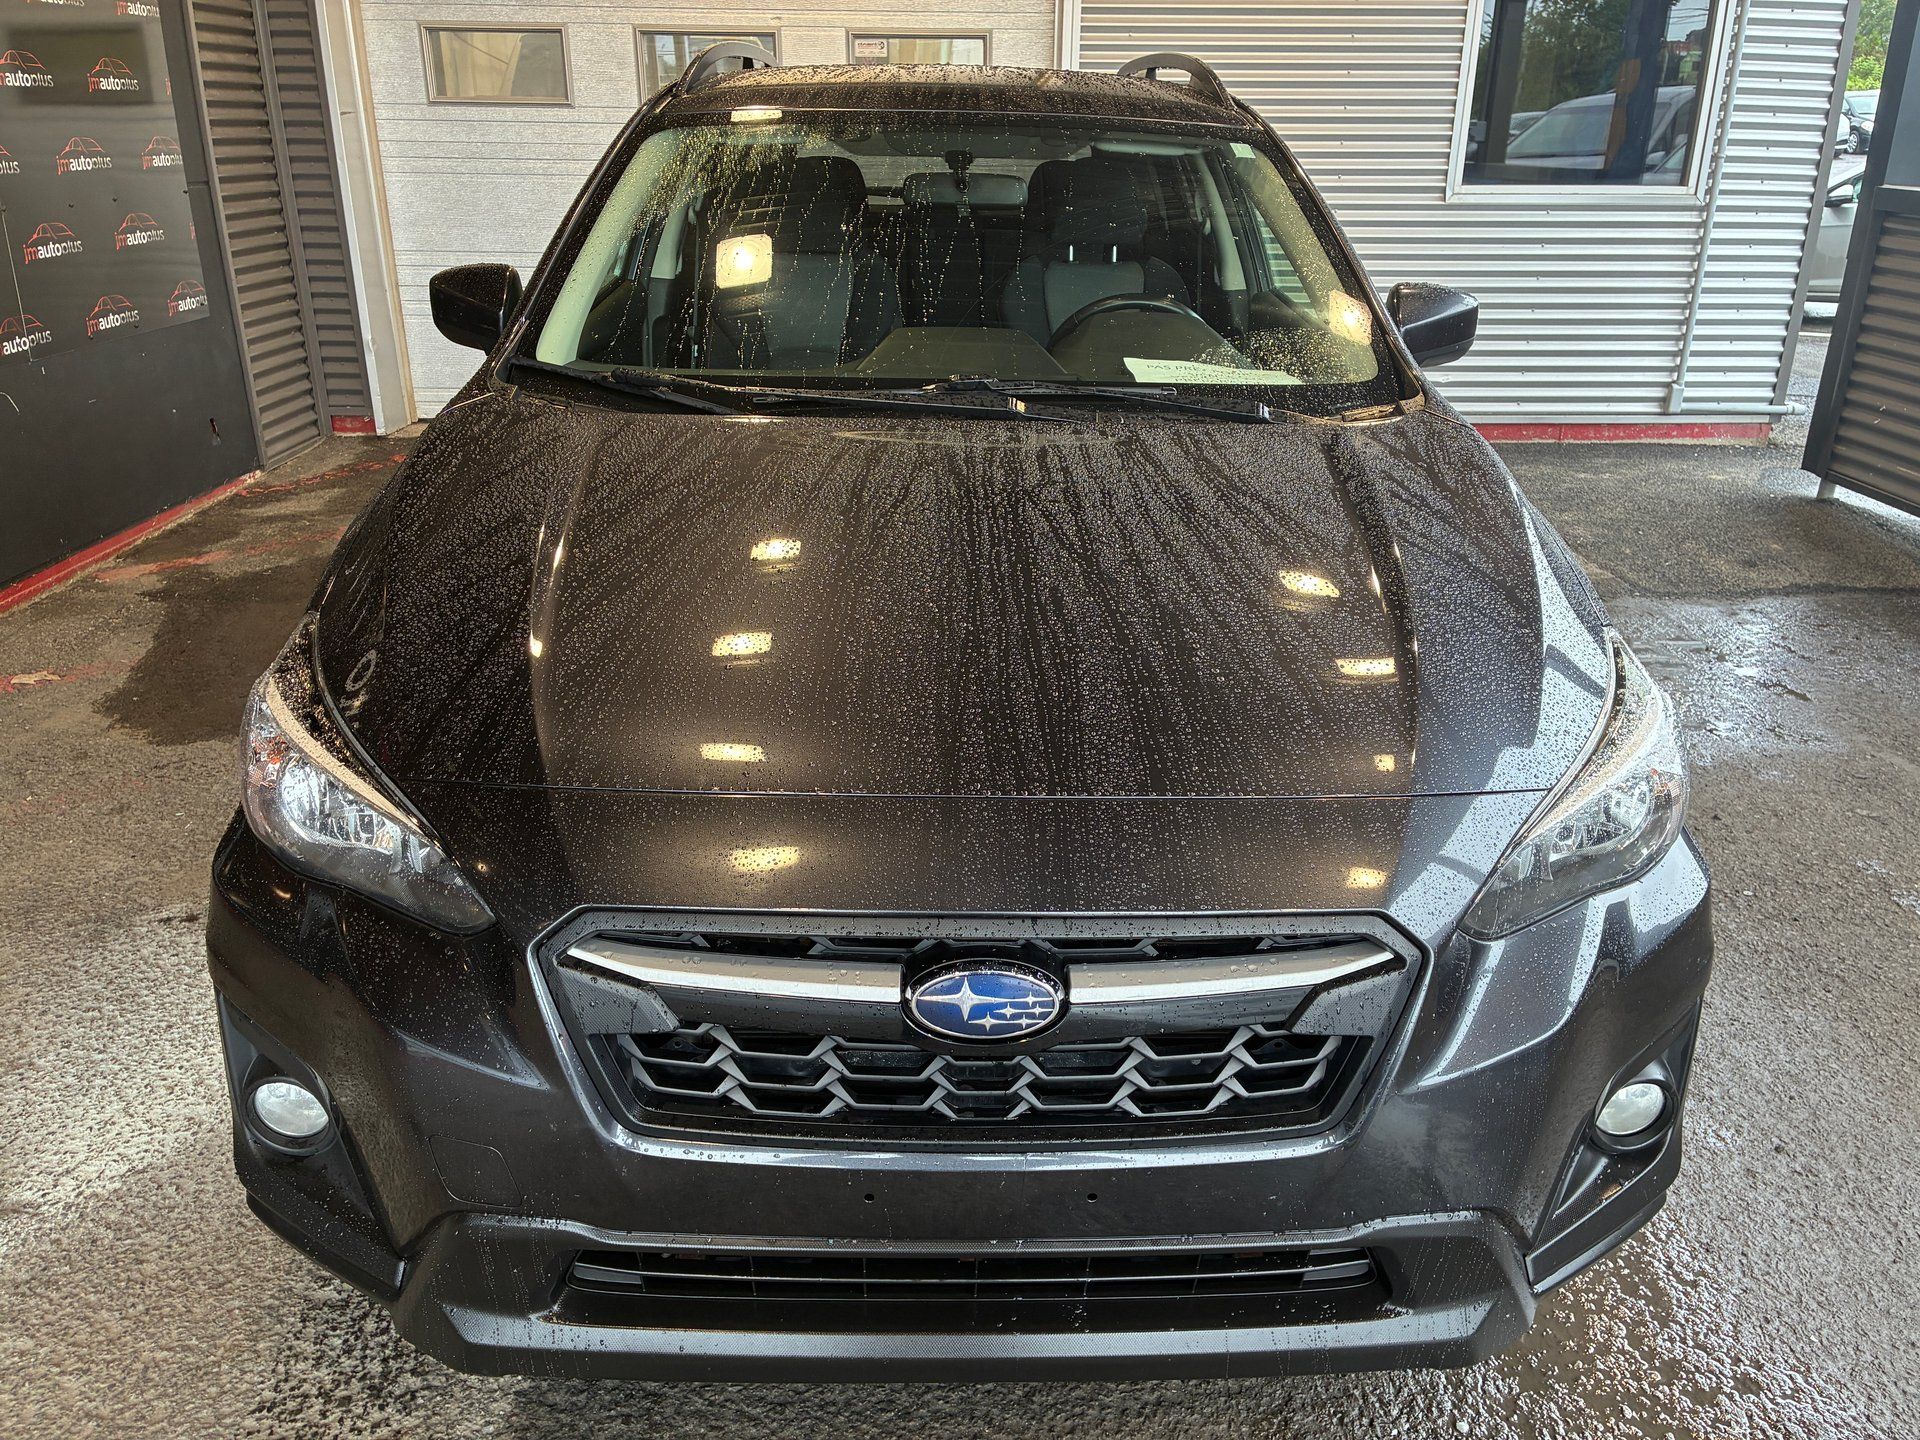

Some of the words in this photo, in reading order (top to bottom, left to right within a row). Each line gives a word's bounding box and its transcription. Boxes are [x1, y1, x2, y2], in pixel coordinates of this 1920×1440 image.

[115, 0, 160, 17] jmautoplu
[87, 73, 139, 93] jmautoplus
[56, 155, 112, 176] jmautoplus
[141, 152, 183, 170] jmautoplu
[114, 228, 165, 251] jmautoplus
[22, 239, 83, 264] jmautoplus
[167, 294, 208, 317] jmautoplu
[86, 309, 139, 337] jmautoplus
